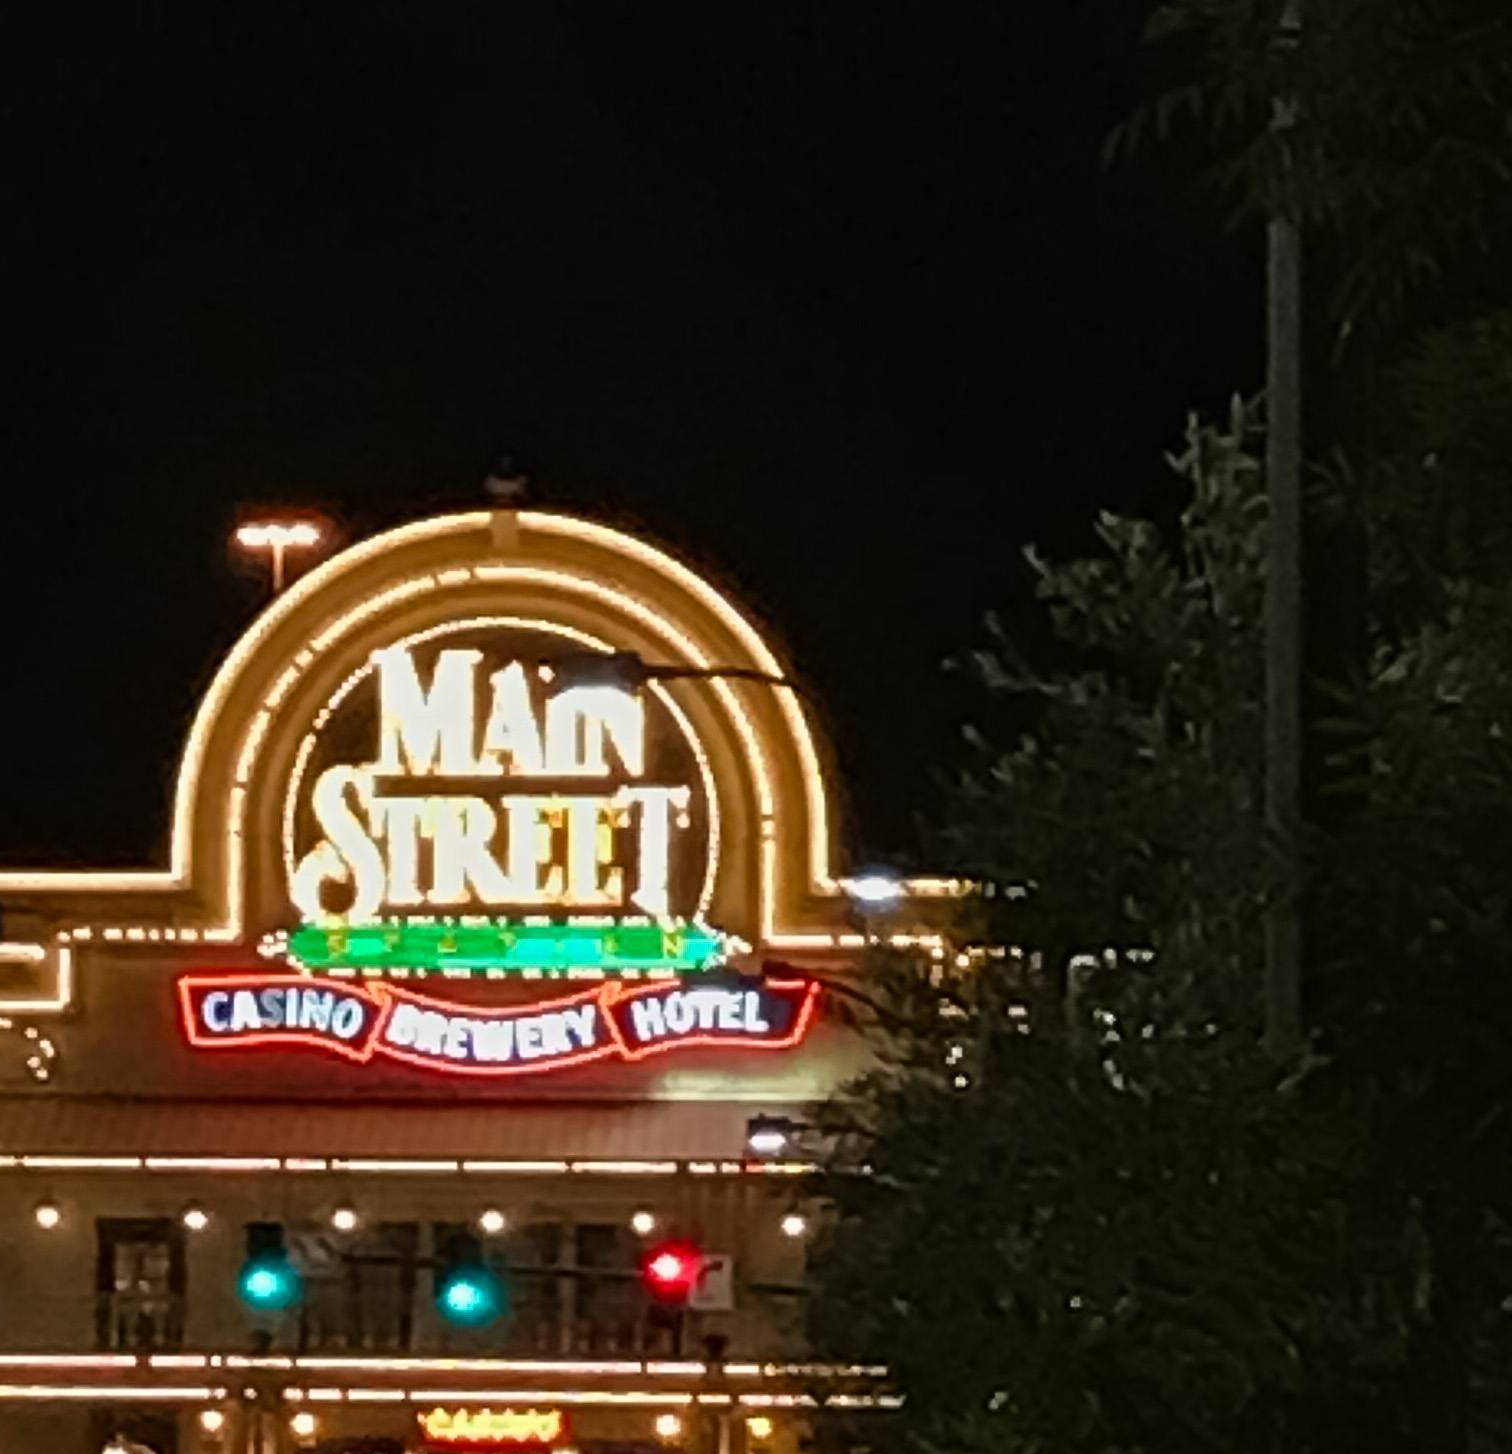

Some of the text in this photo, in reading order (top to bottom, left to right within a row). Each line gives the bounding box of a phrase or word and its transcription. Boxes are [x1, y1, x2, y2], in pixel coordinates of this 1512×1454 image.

[292, 764, 691, 926] STREET
[201, 987, 769, 1063] CASINO BREWERY HOTEL
